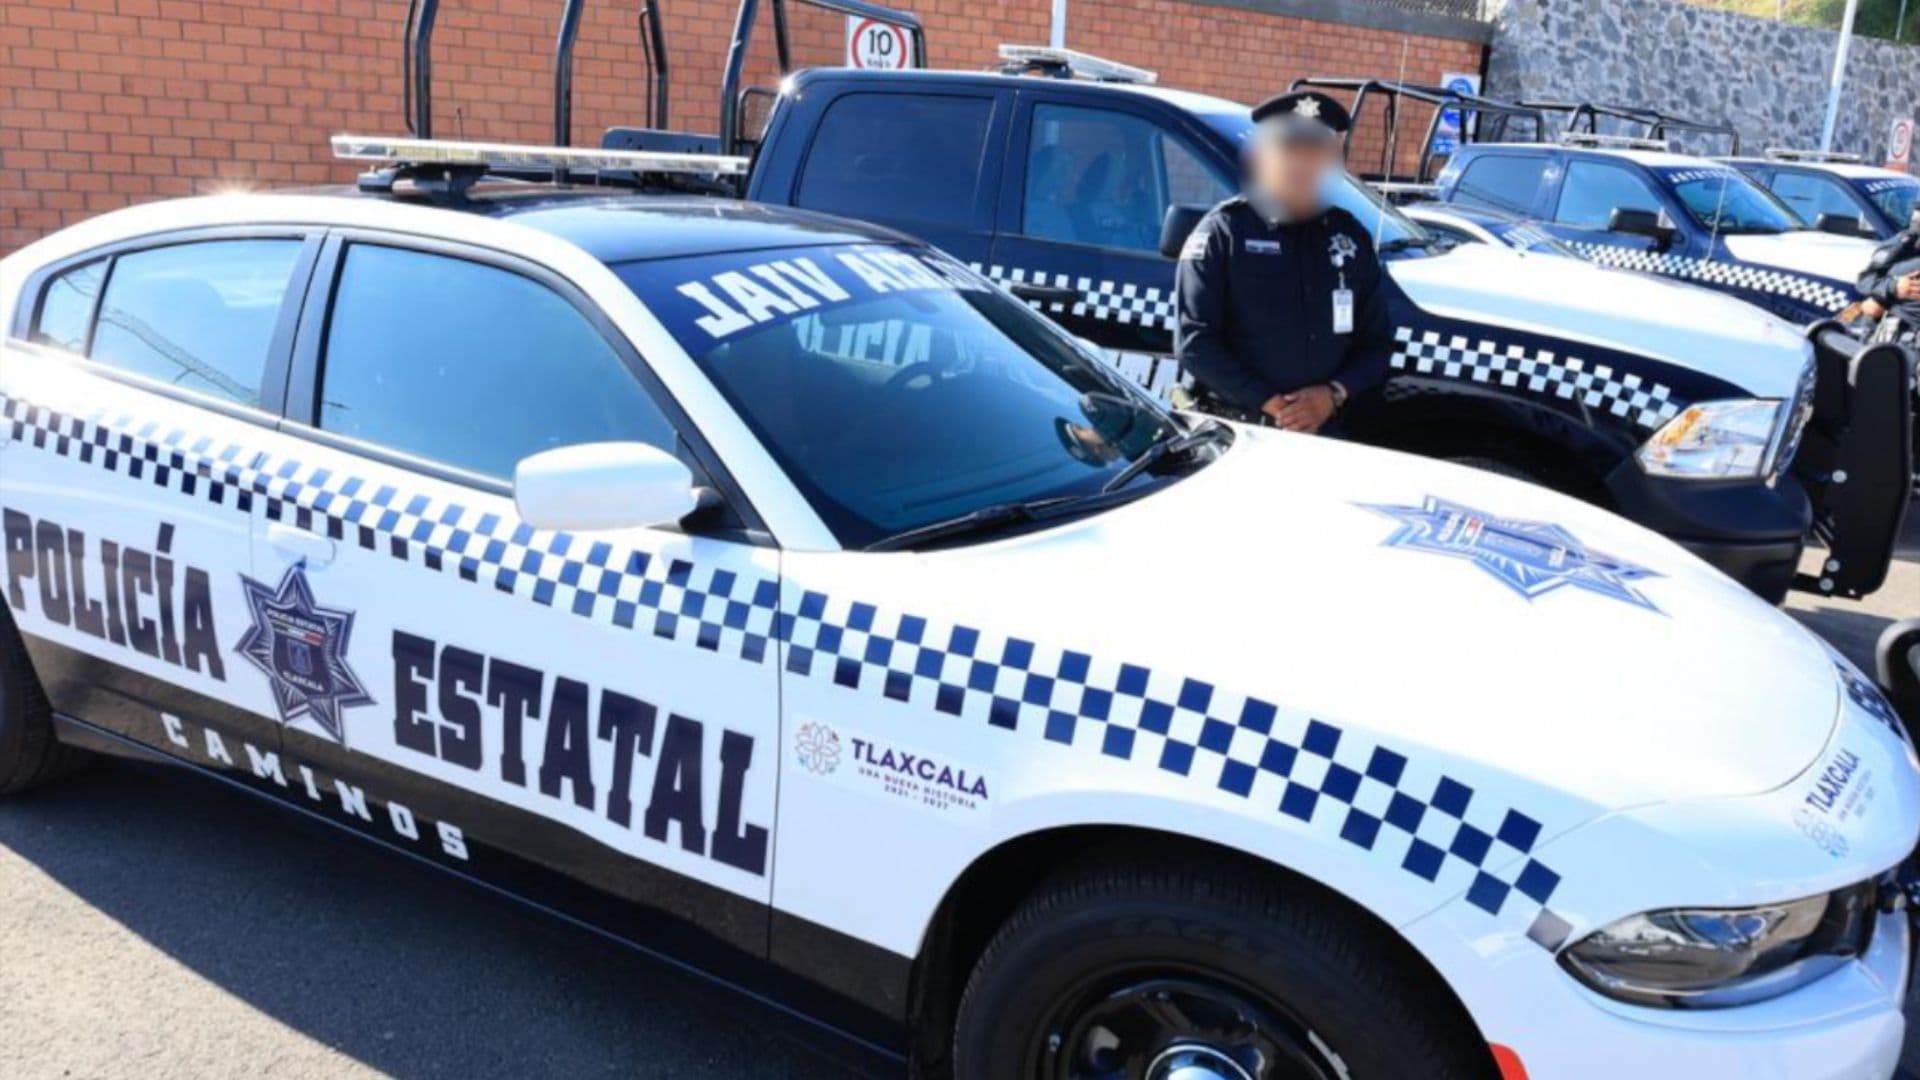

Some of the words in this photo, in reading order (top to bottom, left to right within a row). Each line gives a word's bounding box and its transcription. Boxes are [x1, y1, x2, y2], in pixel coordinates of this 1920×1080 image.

[868, 29, 893, 56] 10
[3, 507, 226, 682] POLICÍA
[160, 712, 469, 860] CAMINOS
[392, 629, 769, 877] ESTATAL
[851, 738, 988, 800] TLAXCALA
[1806, 748, 1860, 814] TLAXCALA
[923, 786, 977, 810] HISTORIA
